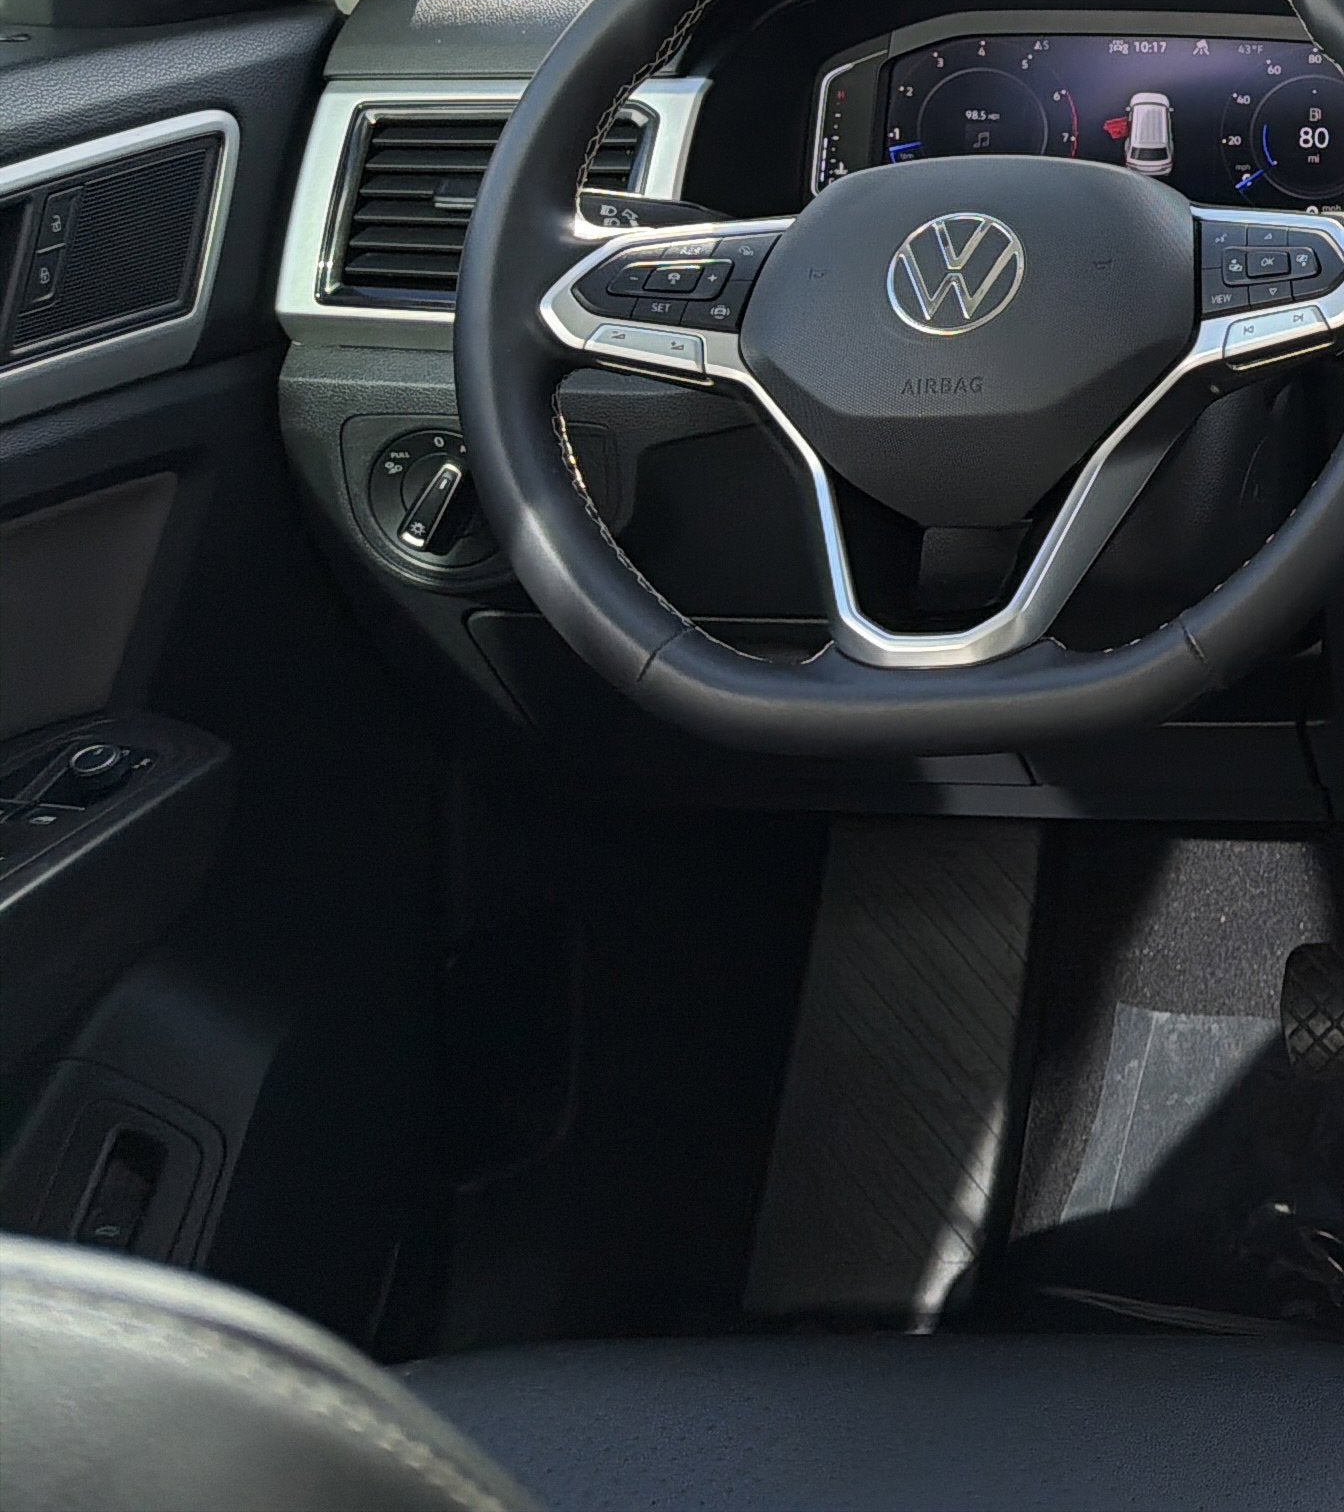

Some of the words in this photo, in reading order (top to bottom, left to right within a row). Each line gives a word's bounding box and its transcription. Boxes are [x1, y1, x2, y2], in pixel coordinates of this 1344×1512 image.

[1134, 41, 1167, 54] 10:17
[1238, 44, 1264, 55] 43°F
[936, 58, 944, 68] 3
[1308, 54, 1322, 64] 80
[1021, 59, 1029, 70] 5
[1267, 65, 1282, 75] 60
[906, 87, 914, 97] 2
[1053, 91, 1061, 102] 6
[1237, 95, 1251, 105] 40
[965, 110, 987, 120] 98.5
[894, 127, 900, 140] 1
[1061, 133, 1069, 143] 7
[1298, 127, 1330, 149] 80
[1228, 136, 1241, 146] 20
[1307, 154, 1320, 164] mi
[1261, 257, 1275, 267] OK
[1211, 293, 1232, 304] VIEW
[651, 303, 671, 313] SET
[901, 375, 984, 395] AIRBAG
